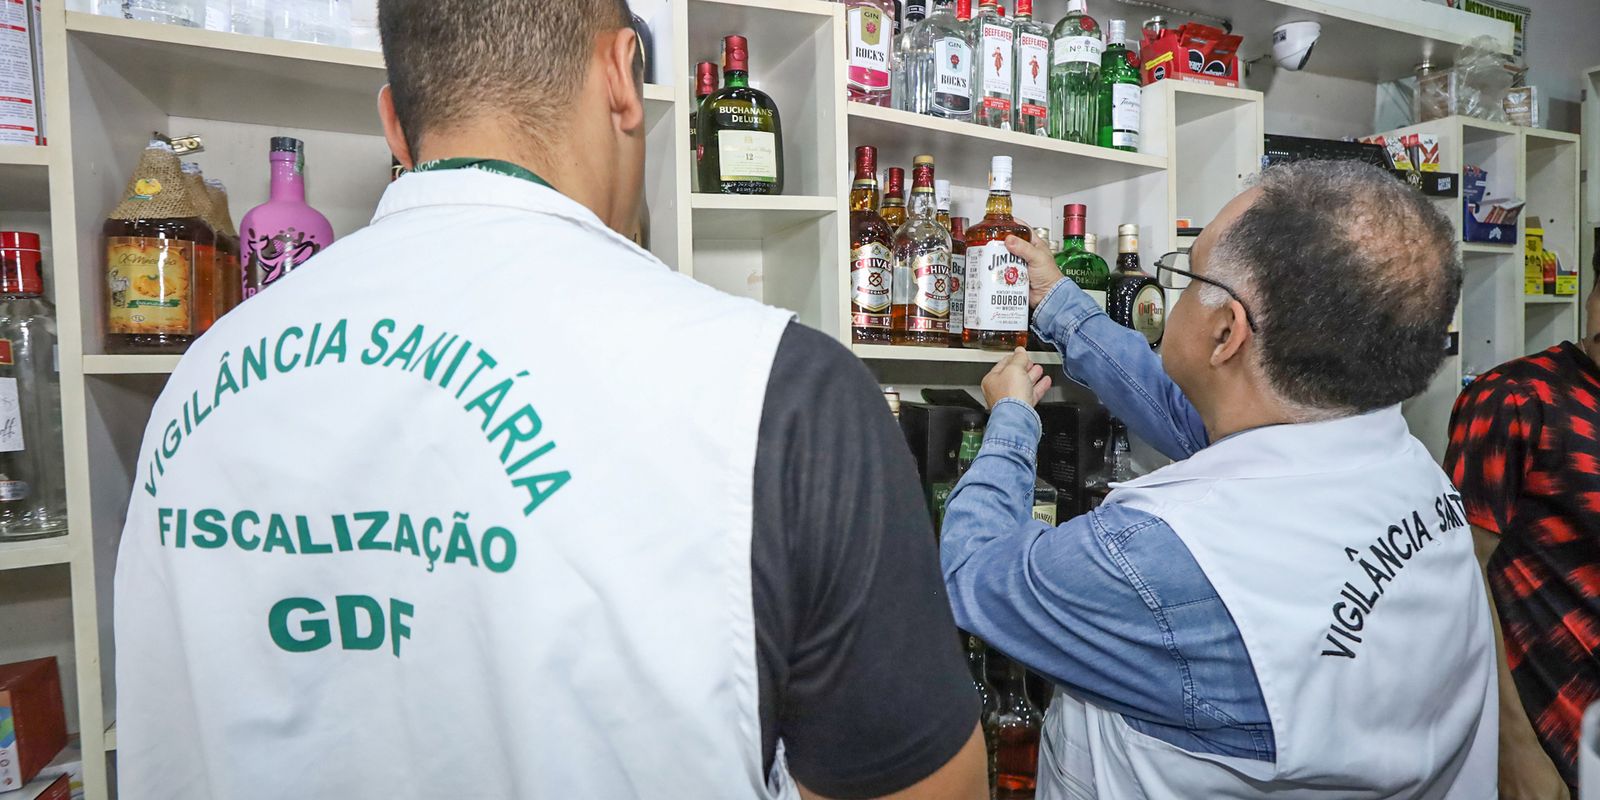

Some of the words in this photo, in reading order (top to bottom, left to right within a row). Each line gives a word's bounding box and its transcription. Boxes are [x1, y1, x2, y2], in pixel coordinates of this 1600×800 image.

[864, 11, 879, 19] GIN
[984, 27, 1012, 41] BEEFEATER
[1021, 35, 1048, 49] BEEFEATER
[855, 46, 885, 62] ROCK'S
[941, 74, 967, 88] ROCK'S
[719, 106, 773, 117] BUCHANAN'S
[855, 258, 892, 270] CHIVAS
[991, 294, 1027, 306] BOURBON
[882, 317, 891, 326] 12
[144, 318, 348, 498] VIGILÂNCIA
[360, 318, 572, 518] SANITÁRIA
[157, 508, 518, 573] FISCALIZAÇÃO
[1321, 510, 1433, 659] VIGILÂNCIA
[268, 594, 415, 659] GDF
